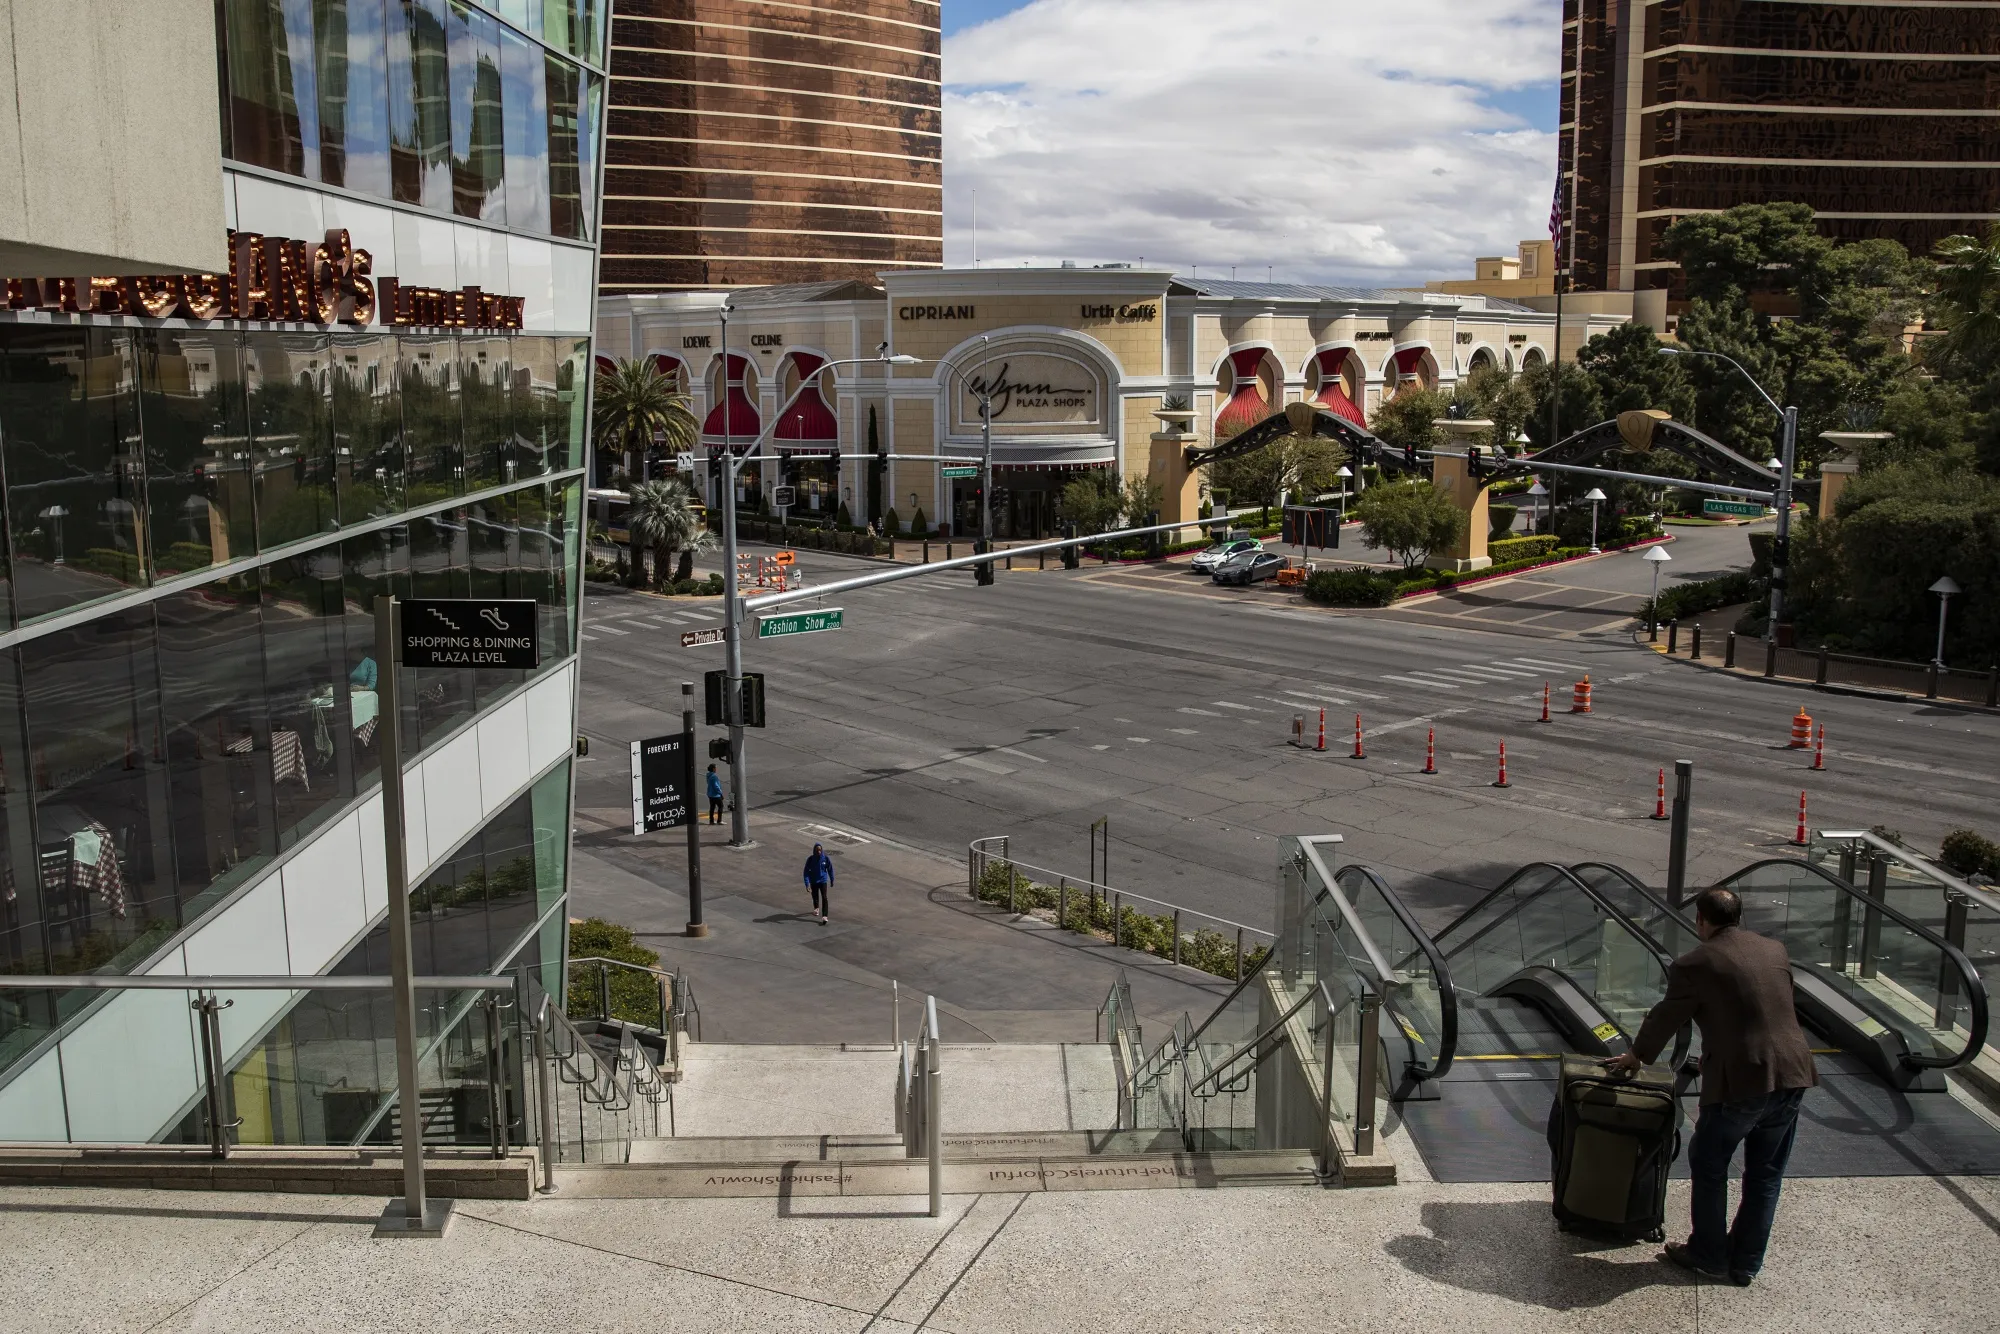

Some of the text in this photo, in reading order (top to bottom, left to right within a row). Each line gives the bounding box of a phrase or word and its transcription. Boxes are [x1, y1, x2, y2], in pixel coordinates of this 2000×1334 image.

[899, 305, 975, 320] CIPRIANI
[1081, 303, 1157, 318] Urth Caffé
[683, 336, 711, 348] LOEWE
[751, 335, 782, 346] CELINE
[1016, 398, 1085, 407] PLAZA SHOPS
[1725, 505, 1747, 513] VEGAS
[768, 620, 797, 634] Fashion
[805, 616, 825, 630] Show
[407, 636, 531, 648] SHOPPING & DINING
[694, 629, 724, 644] Private Dr
[431, 651, 507, 663] PLAZA LEVEL
[647, 742, 679, 754] FOREVER 21
[655, 784, 674, 794] Taxi &
[649, 794, 680, 805] Rideshare
[655, 806, 686, 820] macy's
[657, 818, 675, 828] men's
[941, 1137, 1056, 1147] #TheFutureIsColorfu
[704, 1174, 853, 1185] #FashionShowLV
[989, 1166, 1198, 1181] #TheFutureIsColorful
